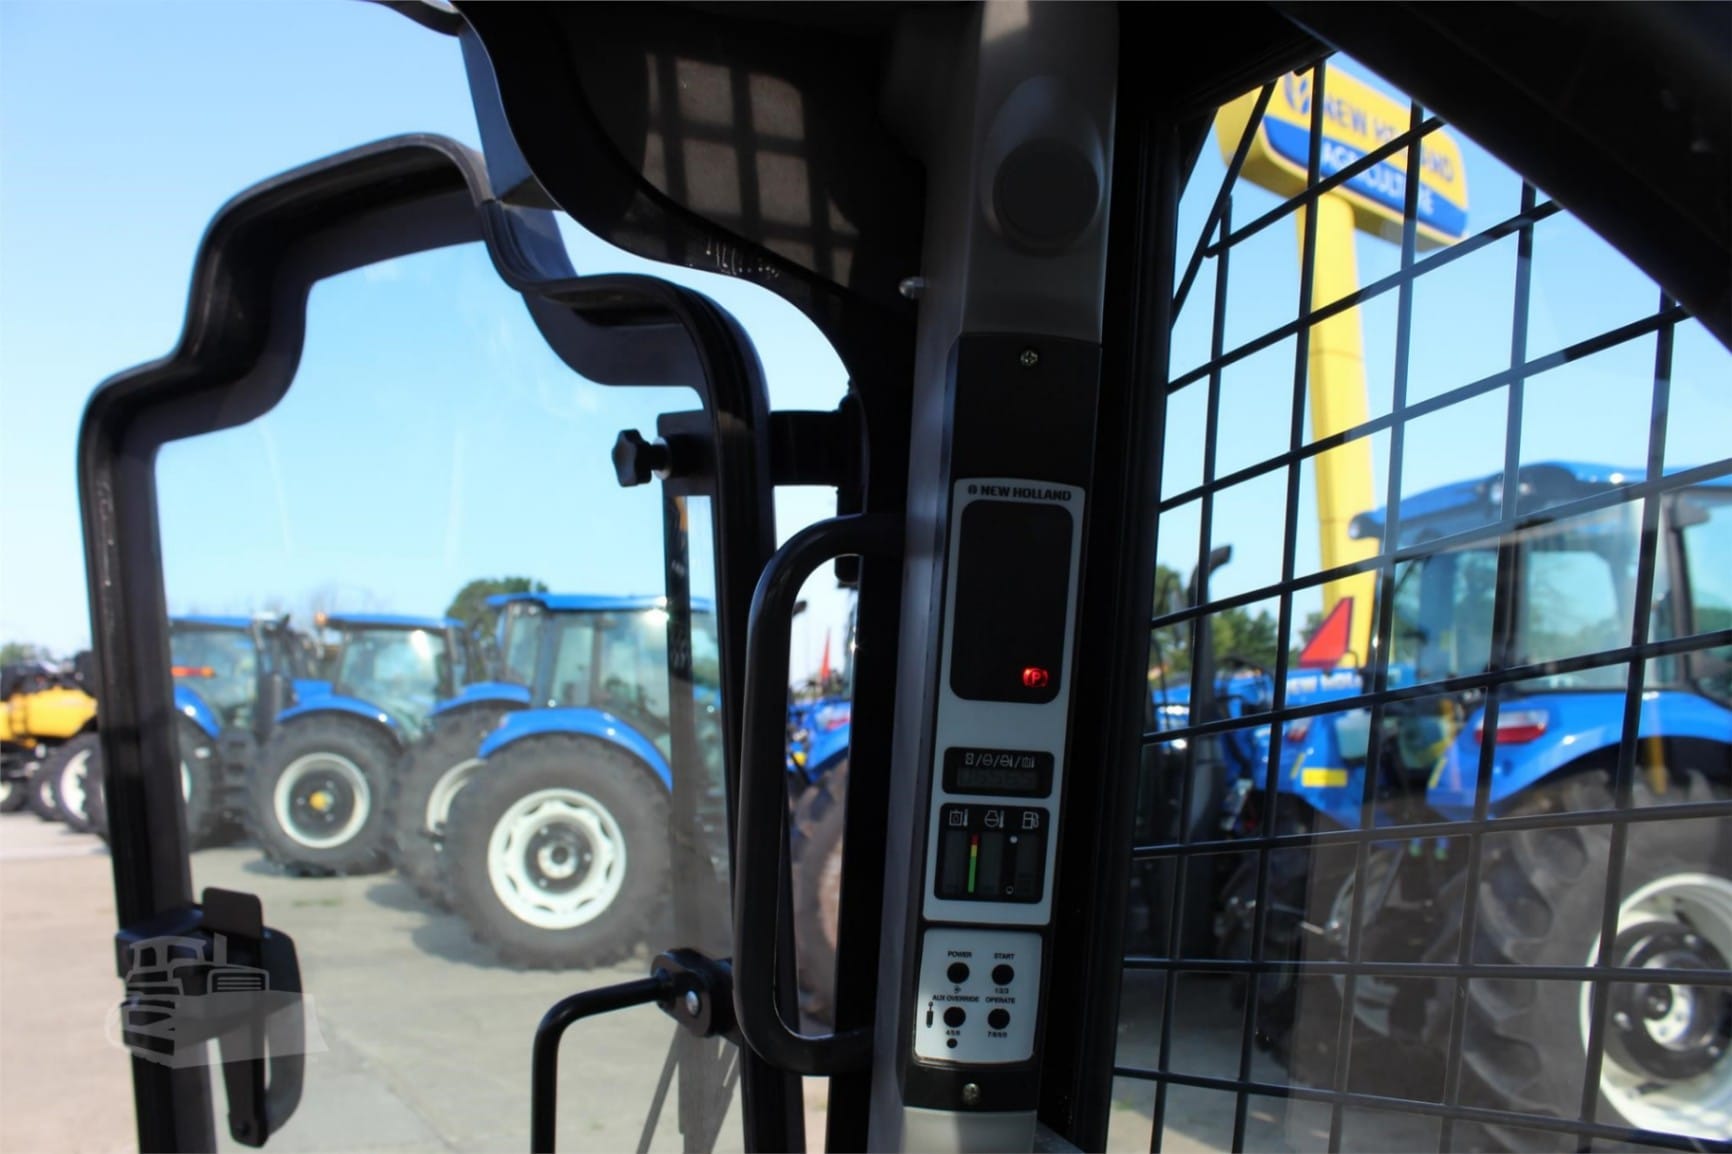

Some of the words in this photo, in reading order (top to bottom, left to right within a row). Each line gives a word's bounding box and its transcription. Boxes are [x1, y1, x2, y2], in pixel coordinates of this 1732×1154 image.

[980, 484, 1010, 497] NEW
[1013, 487, 1072, 501] HOLLAND
[947, 950, 972, 958] POWER
[994, 952, 1015, 960] START
[946, 994, 980, 1003] OVERRIDE
[985, 996, 1016, 1004] OPERATE
